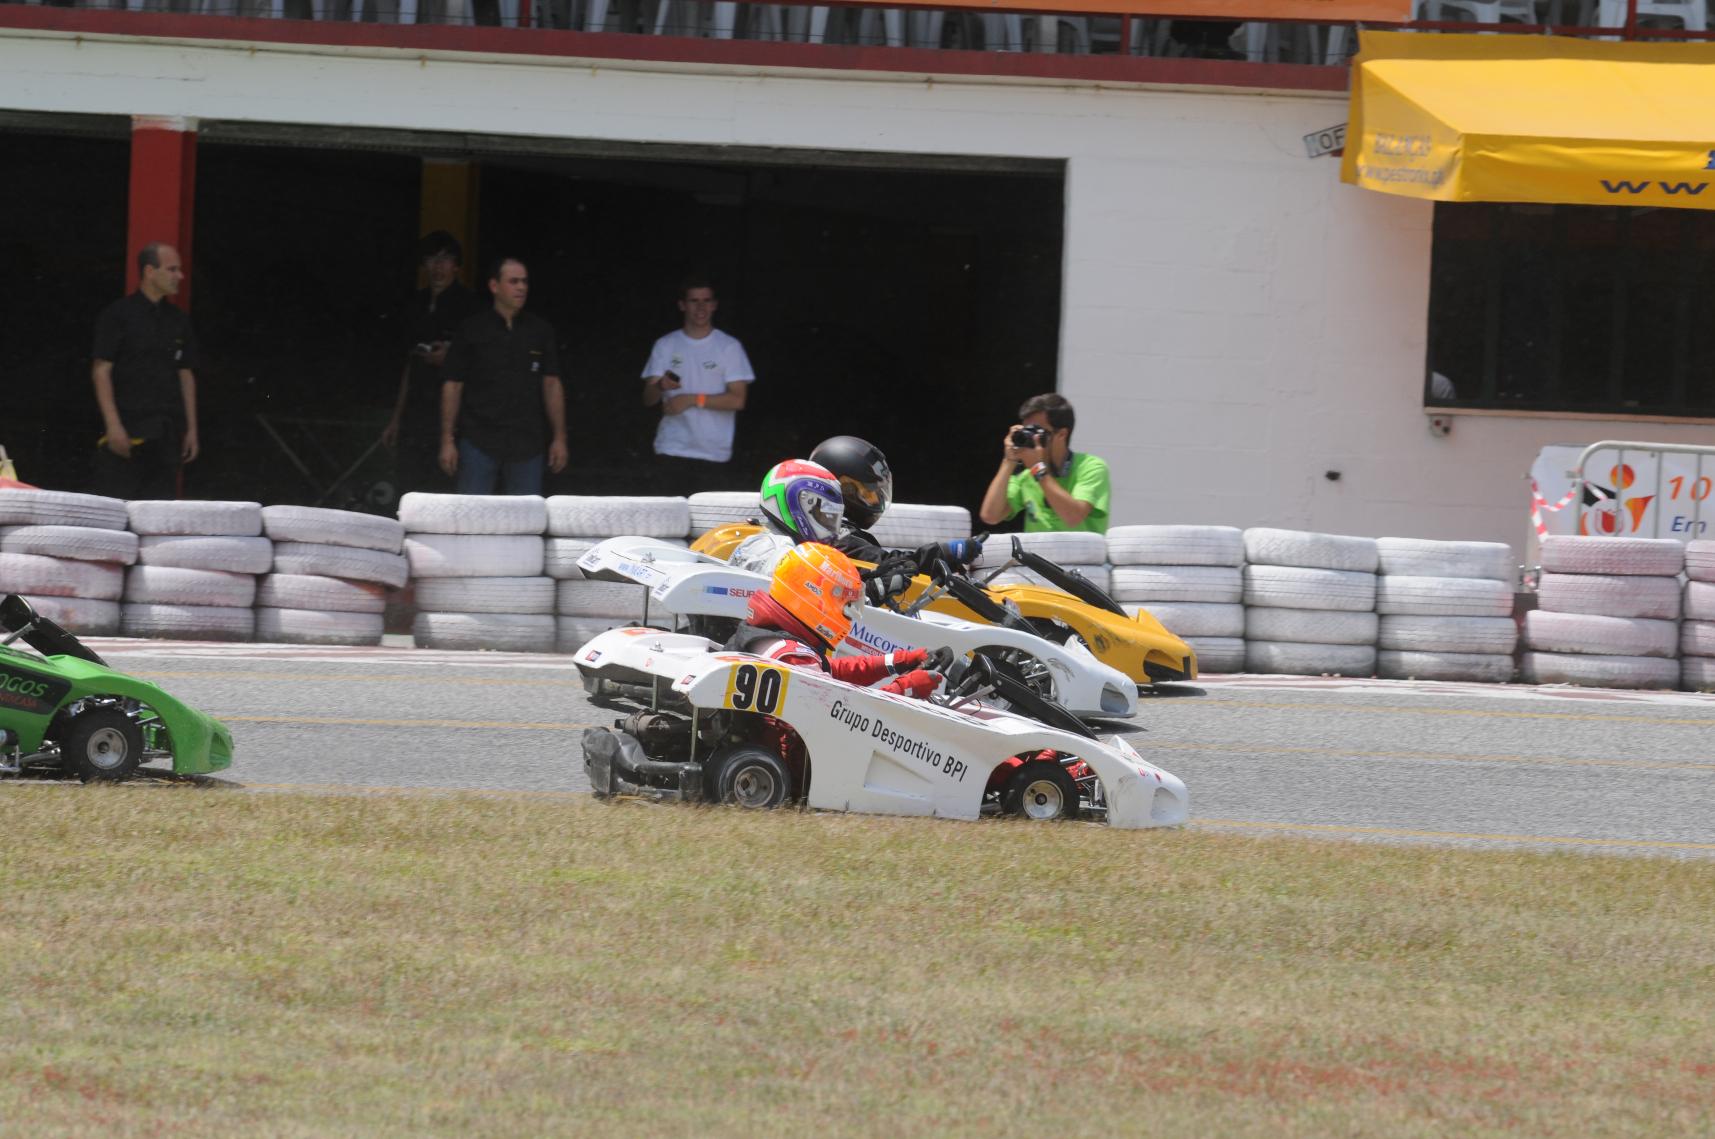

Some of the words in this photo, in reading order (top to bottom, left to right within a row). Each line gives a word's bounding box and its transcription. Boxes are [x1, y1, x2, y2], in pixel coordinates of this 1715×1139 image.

[731, 664, 782, 715] 90
[830, 700, 869, 732] Grupo
[871, 719, 941, 767] Desportivo
[943, 755, 968, 783] BPI
